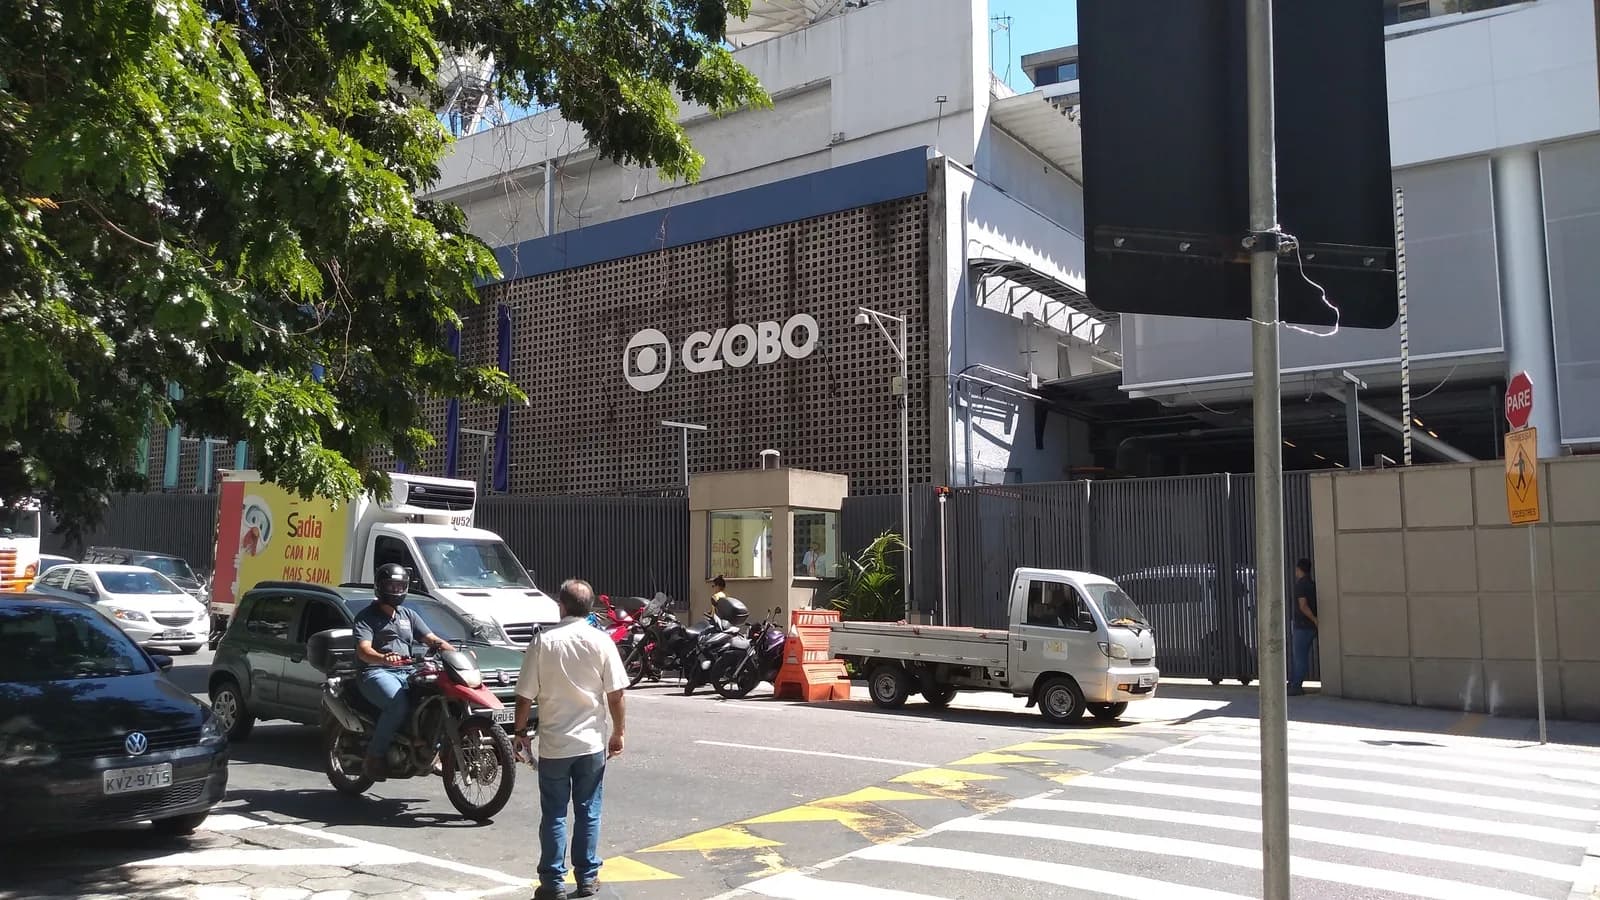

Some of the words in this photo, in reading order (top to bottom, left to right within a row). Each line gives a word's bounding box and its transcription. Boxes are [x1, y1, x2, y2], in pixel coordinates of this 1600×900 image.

[682, 313, 819, 373] GLOBO
[1507, 389, 1530, 414] PARE
[287, 512, 322, 538] Sadia
[284, 545, 304, 560] CADA
[307, 545, 320, 560] DIA
[282, 566, 303, 581] MAIS
